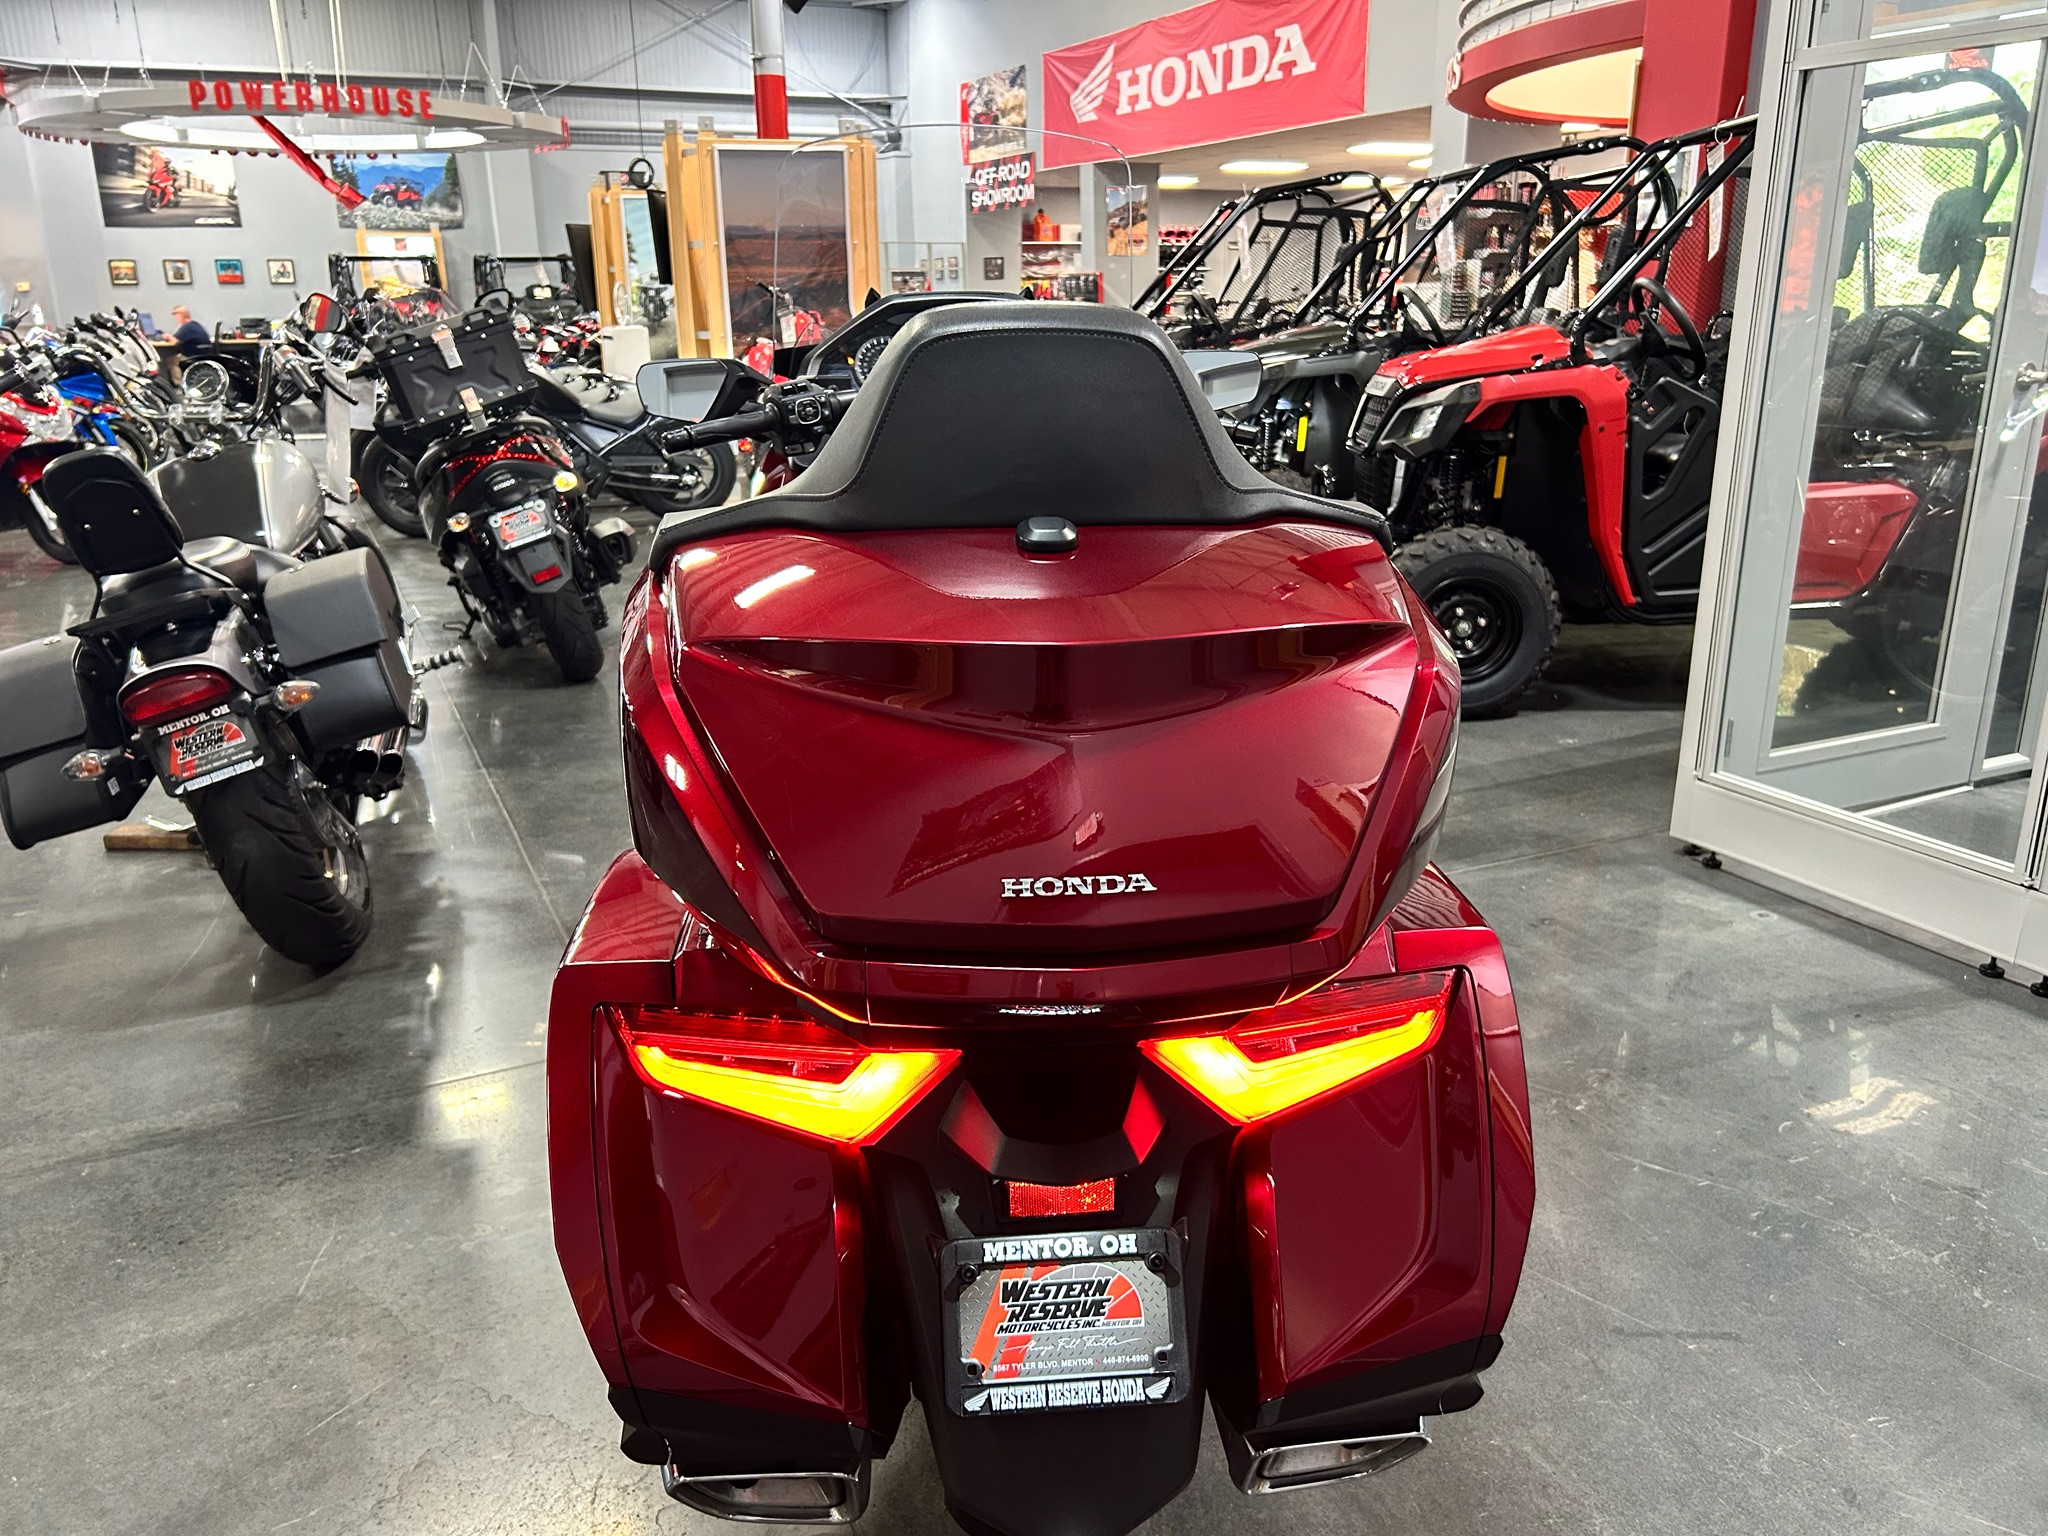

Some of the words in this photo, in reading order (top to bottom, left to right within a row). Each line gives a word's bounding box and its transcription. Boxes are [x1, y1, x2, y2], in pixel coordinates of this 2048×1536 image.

[1115, 23, 1317, 116] HONDA
[188, 80, 435, 120] POWERHOUSE
[971, 184, 1035, 208] SHOWROOM
[211, 704, 231, 717] OH
[173, 726, 224, 750] WESTERN
[181, 735, 226, 759] RESERVE
[1001, 873, 1158, 898] HONDA
[983, 1236, 1094, 1262] MENTOR,
[1100, 1233, 1138, 1254] OH
[1001, 1278, 1112, 1304] WESTERN
[1007, 1298, 1113, 1323] RESERVE
[997, 1319, 1081, 1335] MOTORCYCLES
[1081, 1318, 1101, 1329] INC.
[1006, 1338, 1055, 1356] Always
[1057, 1337, 1080, 1351] Full
[1083, 1335, 1130, 1350] Throttle
[1011, 1362, 1037, 1371] TYLER
[1037, 1360, 1060, 1369] BLVD.
[1061, 1357, 1094, 1367] MENTOR
[990, 1384, 1047, 1411] WESTERN
[1048, 1381, 1101, 1409] RESERVE
[1101, 1377, 1146, 1404] HONDA
